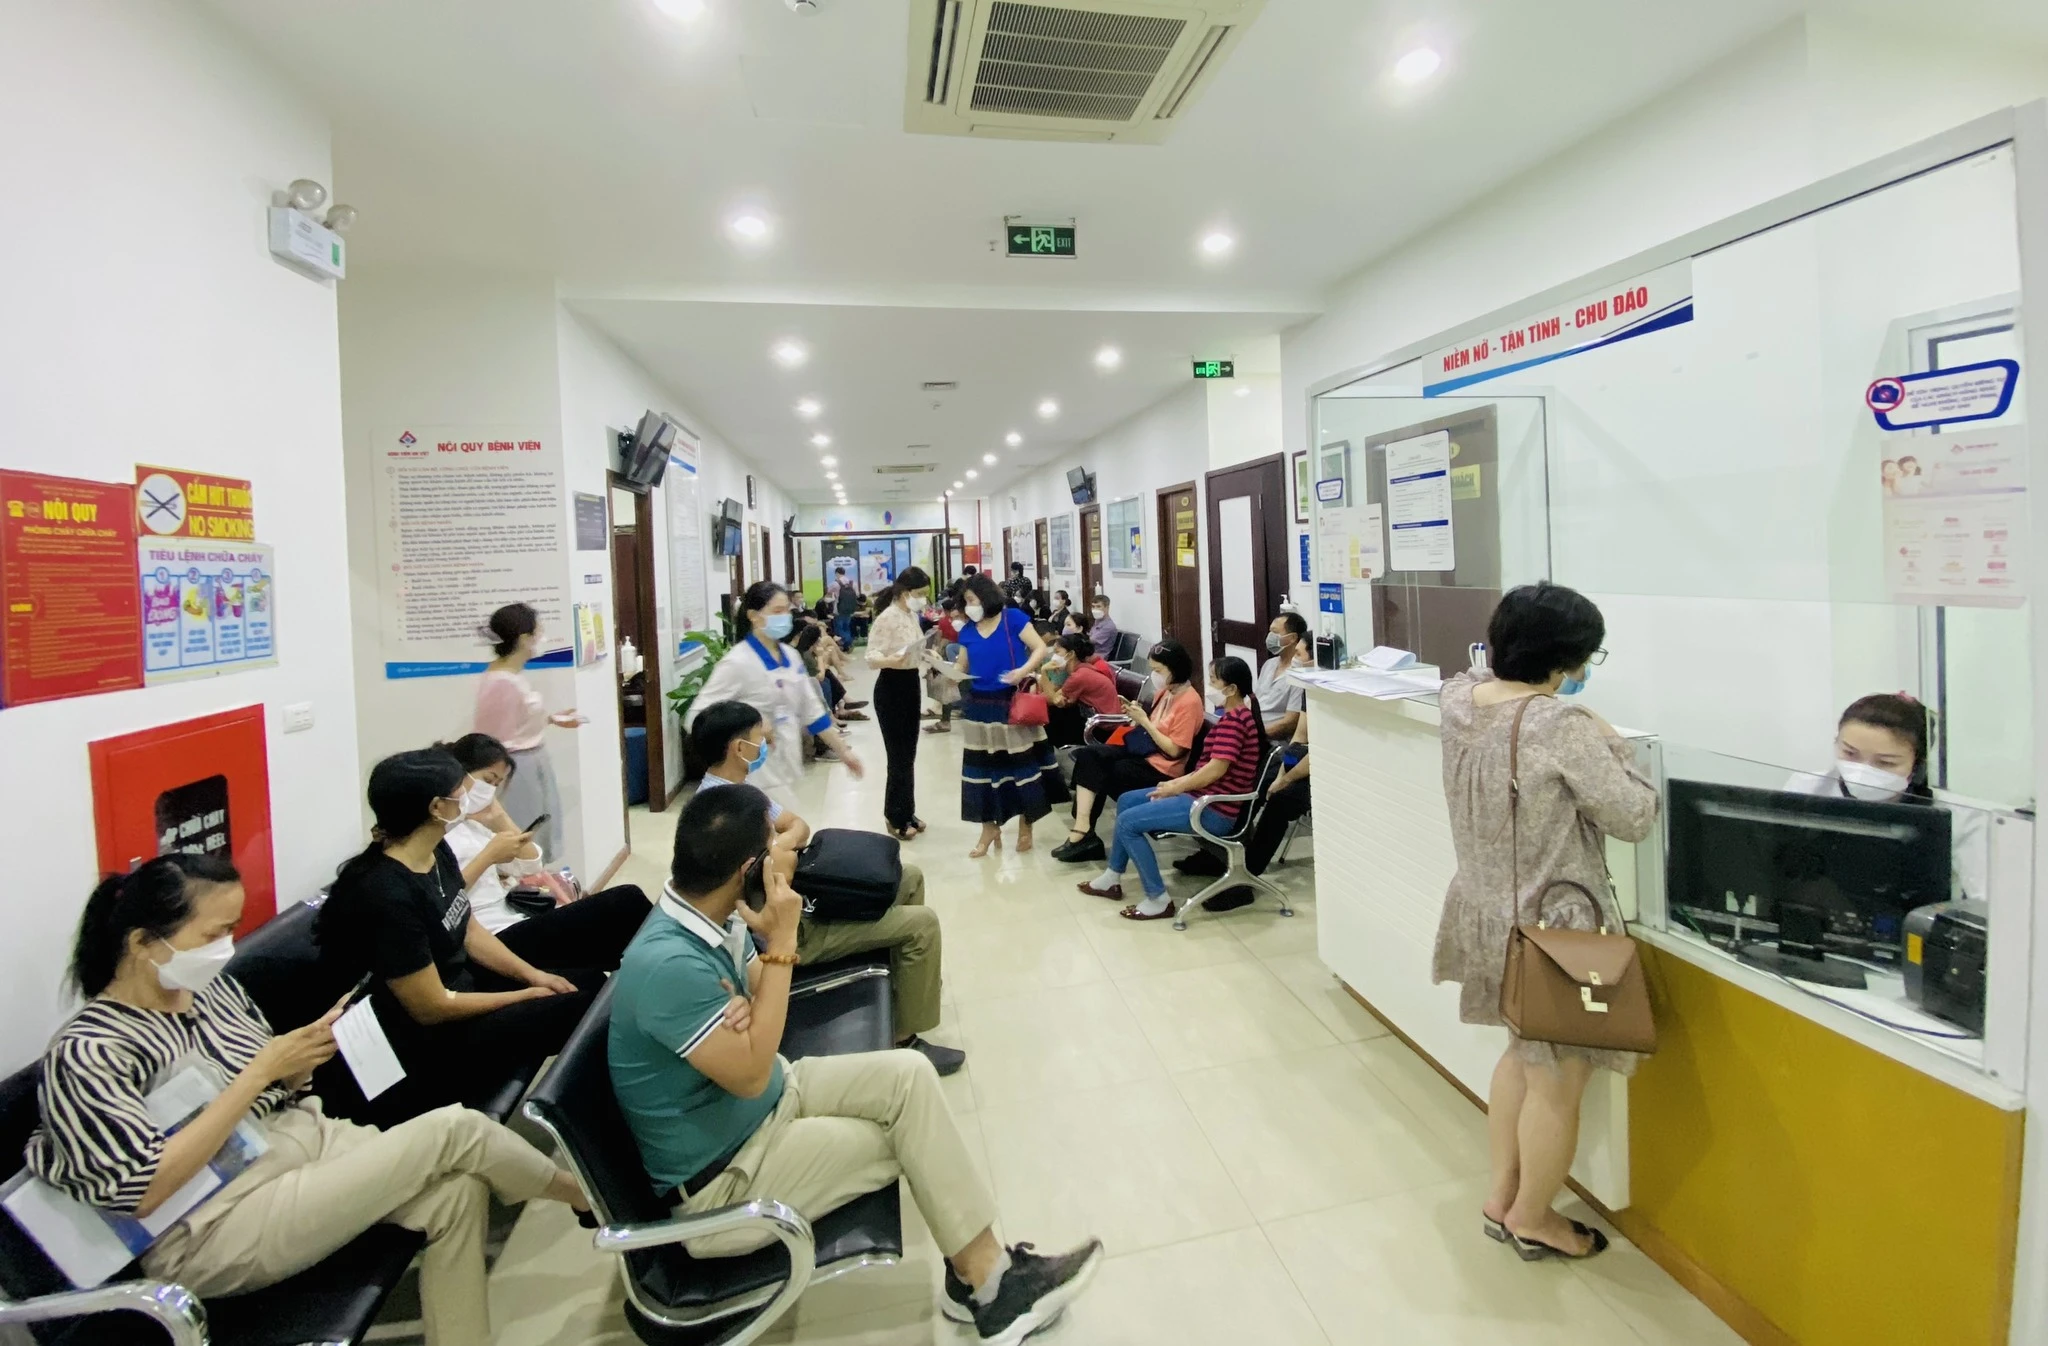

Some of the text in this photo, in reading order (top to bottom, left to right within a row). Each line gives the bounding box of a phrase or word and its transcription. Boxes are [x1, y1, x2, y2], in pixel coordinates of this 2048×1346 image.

[1056, 237, 1072, 248] EXIT
[1443, 347, 1470, 372] NIỀM
[1473, 338, 1489, 363] NỞ
[1500, 330, 1524, 355] TẬN
[1527, 317, 1560, 342] TÌNH
[1575, 300, 1608, 329] CHU
[1613, 286, 1648, 316] ĐÁO
[437, 439, 541, 455] NỘI QUY BỆNH VIỆN
[43, 498, 68, 524] NỘI
[71, 503, 97, 522] QUY
[188, 515, 254, 538] NO SMOKING
[178, 549, 206, 564] LỆNH
